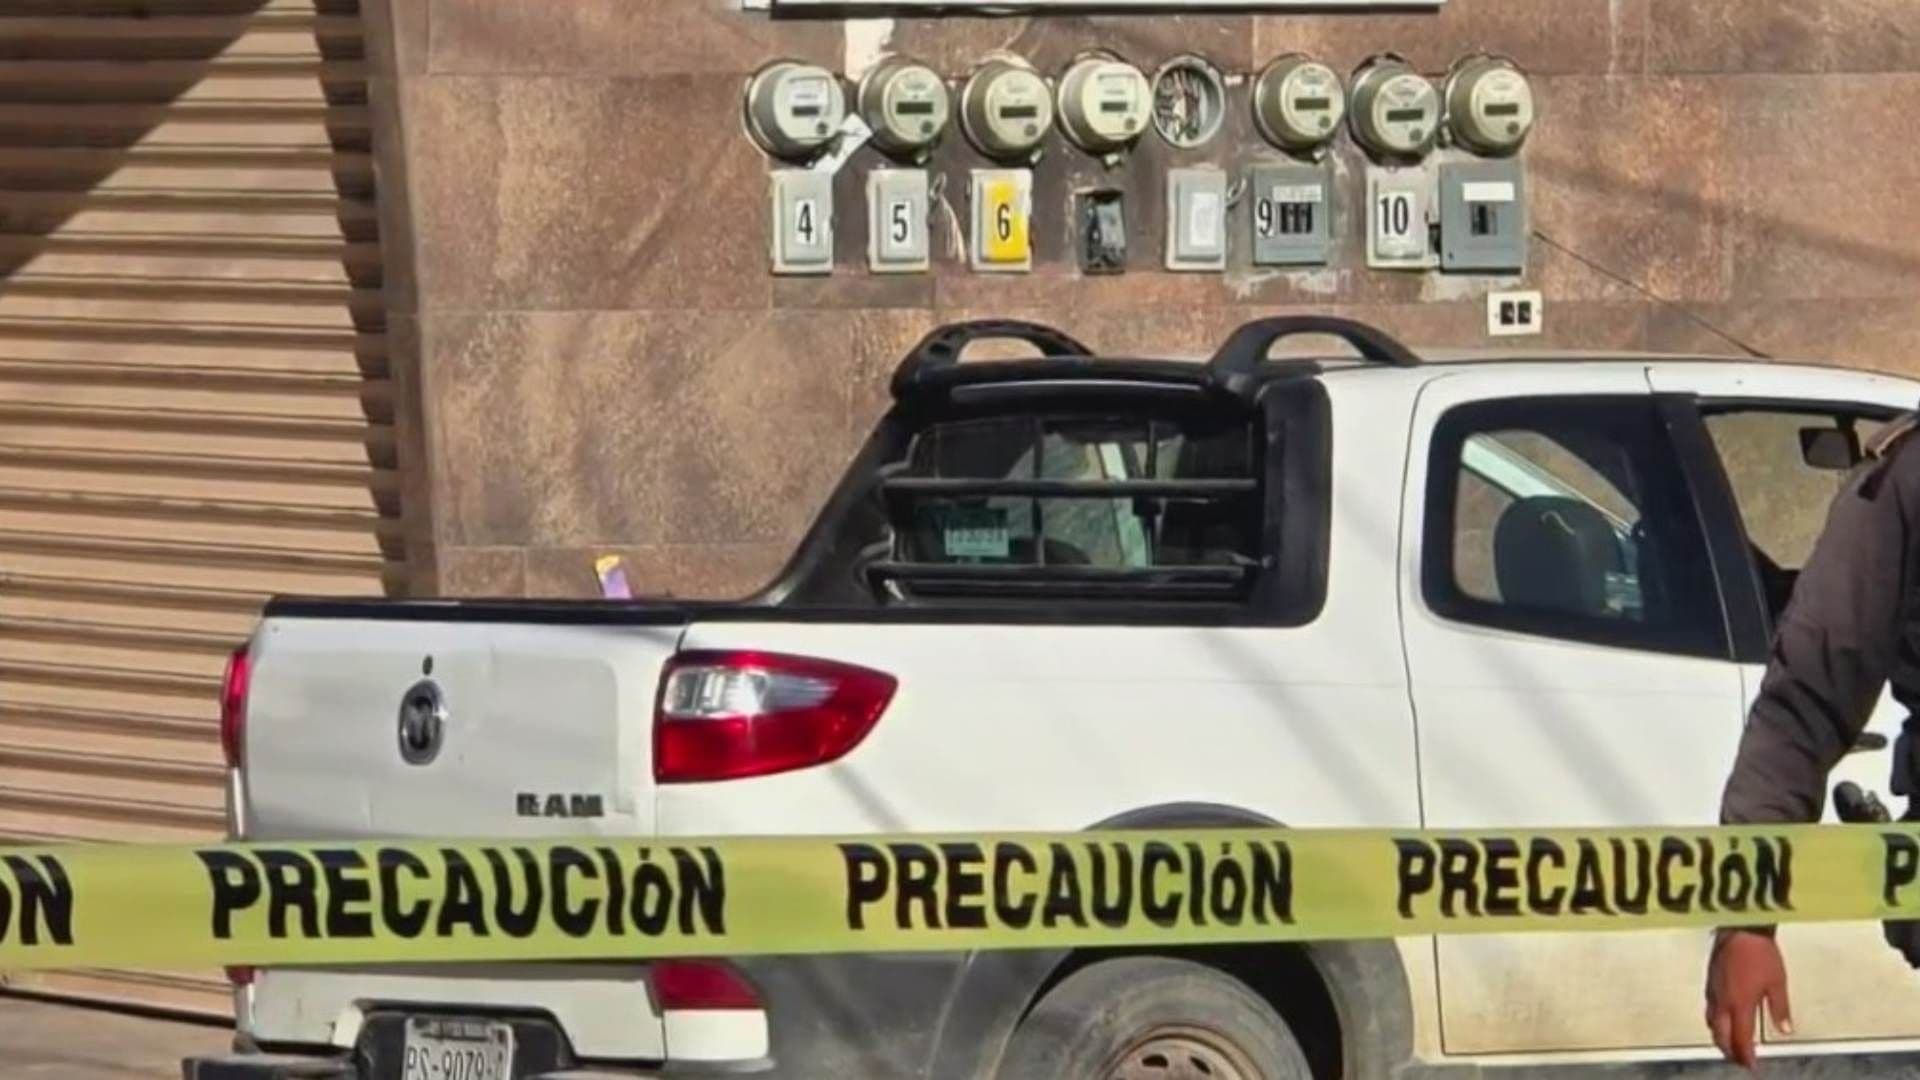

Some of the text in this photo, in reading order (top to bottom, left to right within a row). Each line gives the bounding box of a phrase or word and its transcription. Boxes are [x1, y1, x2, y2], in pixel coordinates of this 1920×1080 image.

[797, 203, 813, 242] 4
[893, 204, 908, 242] 5
[997, 203, 1011, 240] 6
[1258, 197, 1273, 237] 9
[1380, 196, 1409, 235] 10
[516, 793, 604, 818] RAM
